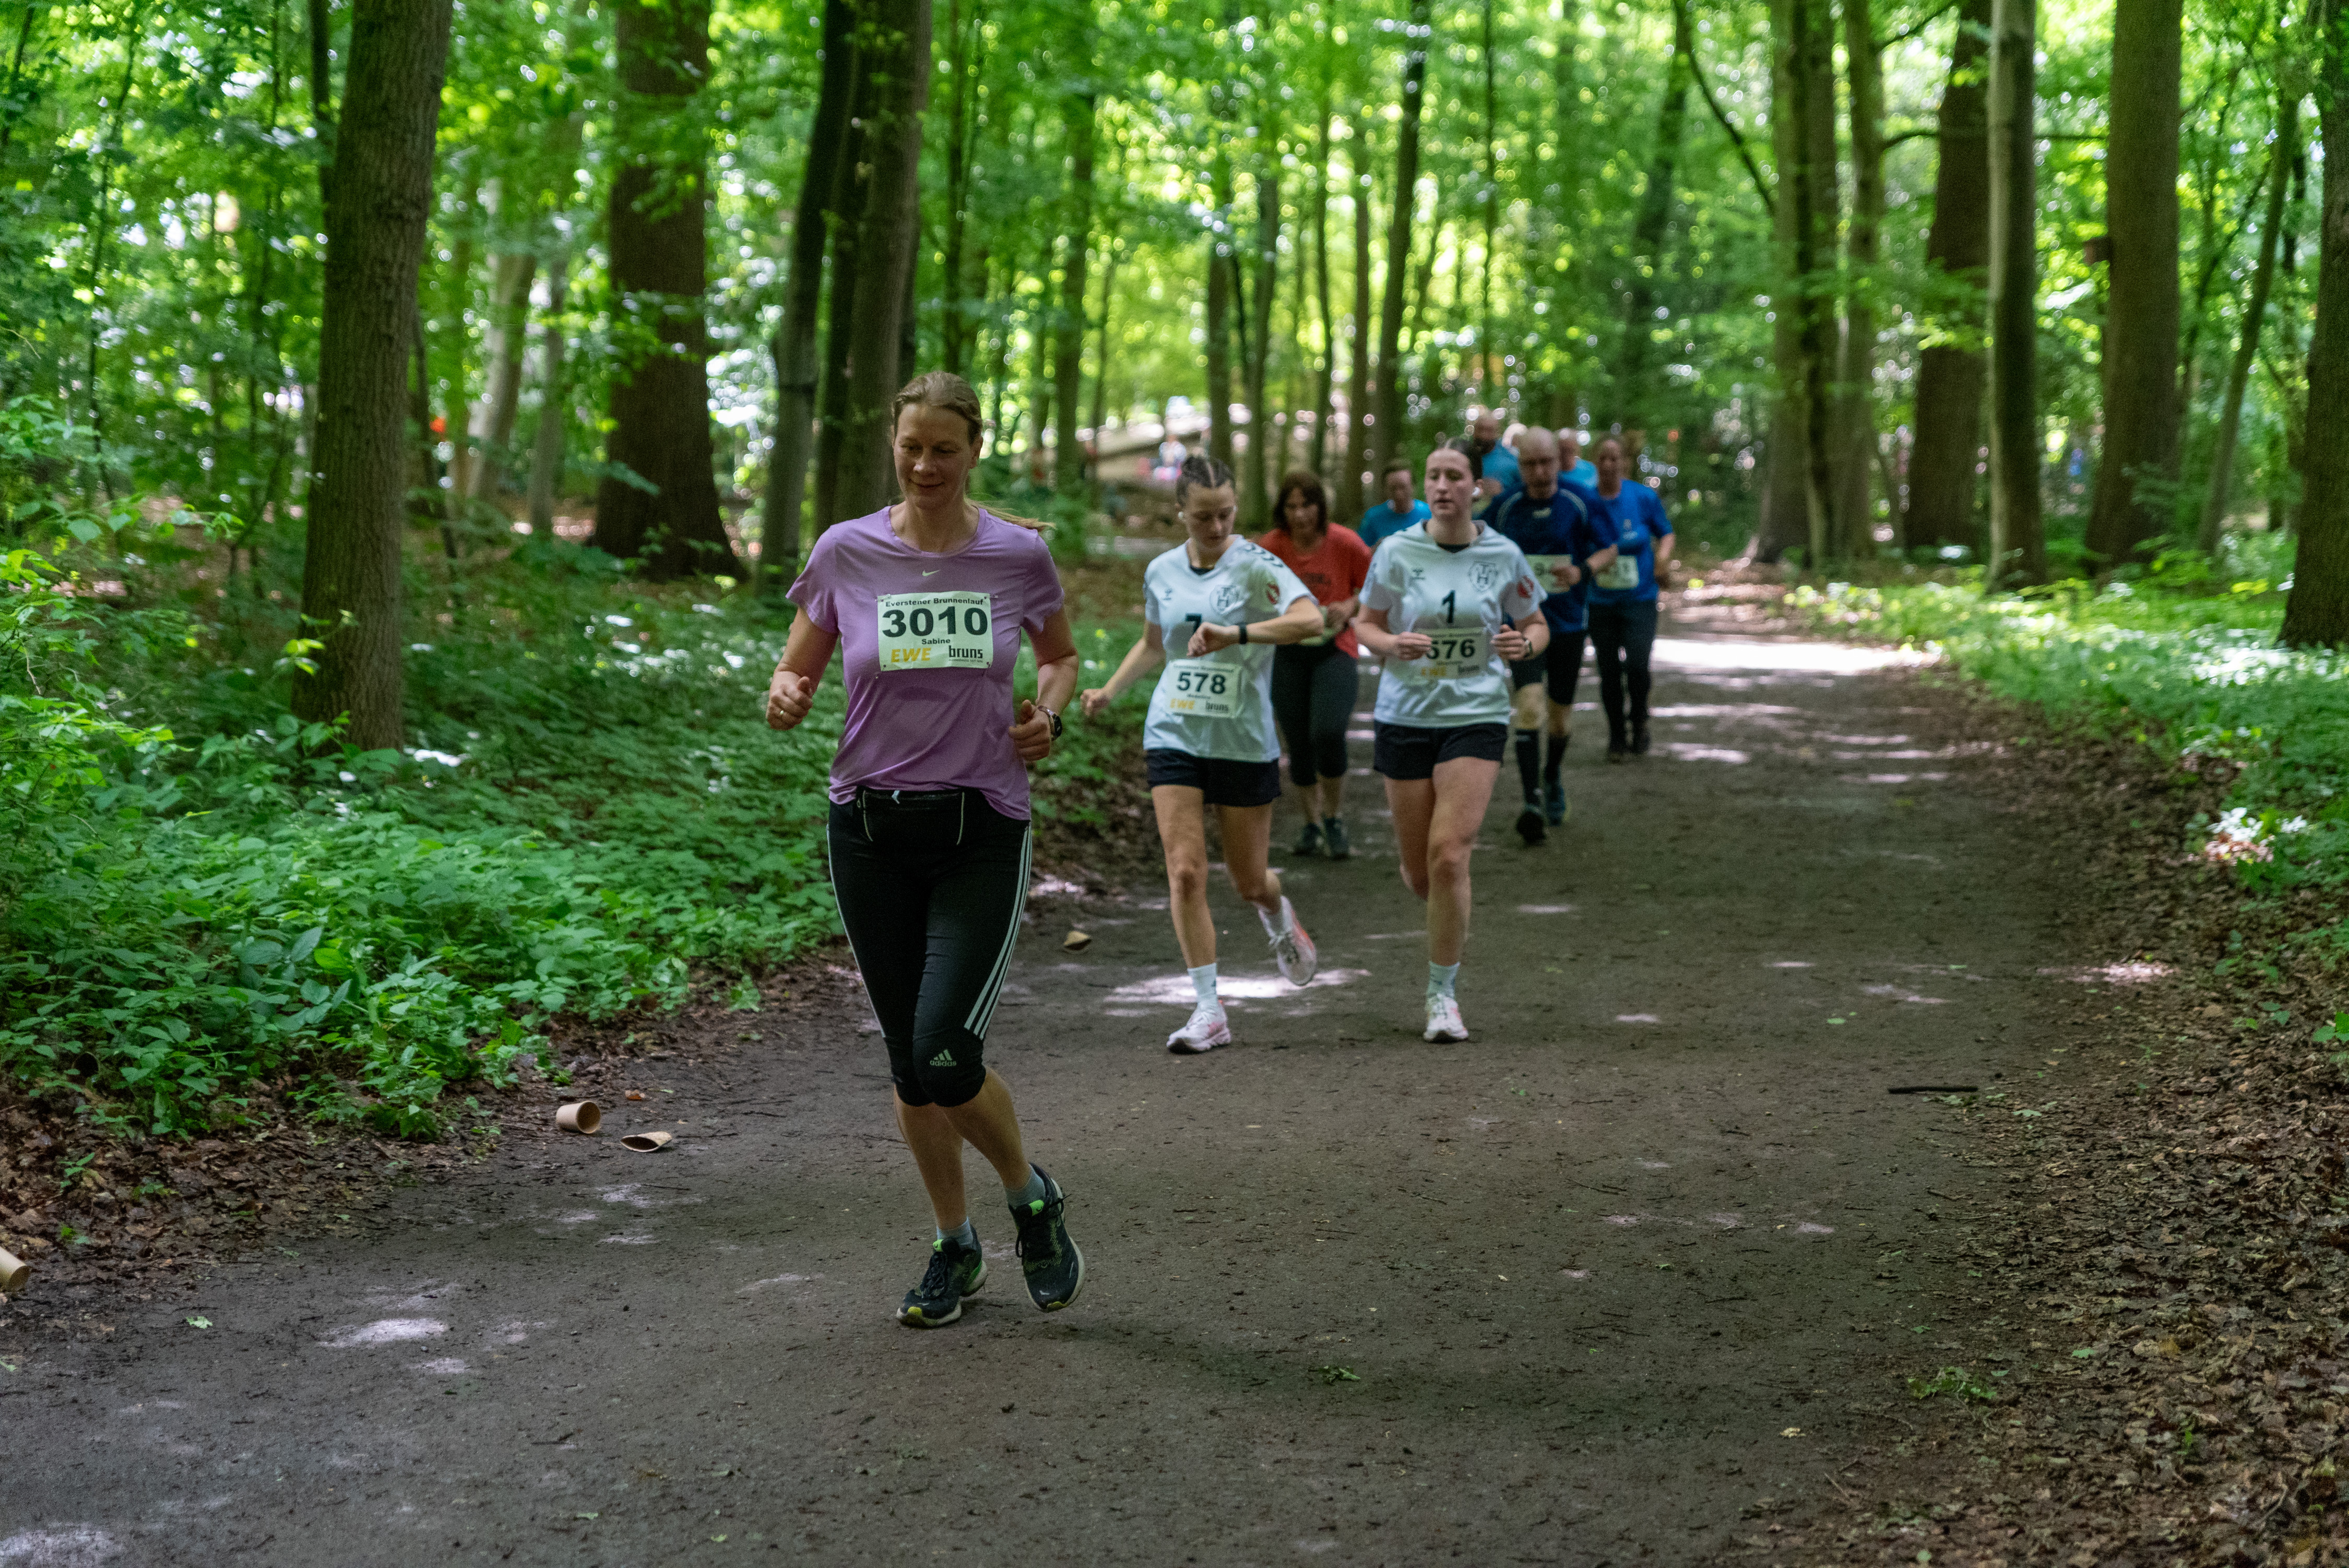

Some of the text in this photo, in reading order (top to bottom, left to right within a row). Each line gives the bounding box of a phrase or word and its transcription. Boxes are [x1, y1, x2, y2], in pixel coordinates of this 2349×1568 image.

[1442, 590, 1456, 623] 1
[882, 606, 988, 637] 3010
[891, 645, 983, 663] EWE bruns
[1177, 671, 1226, 694] 578
